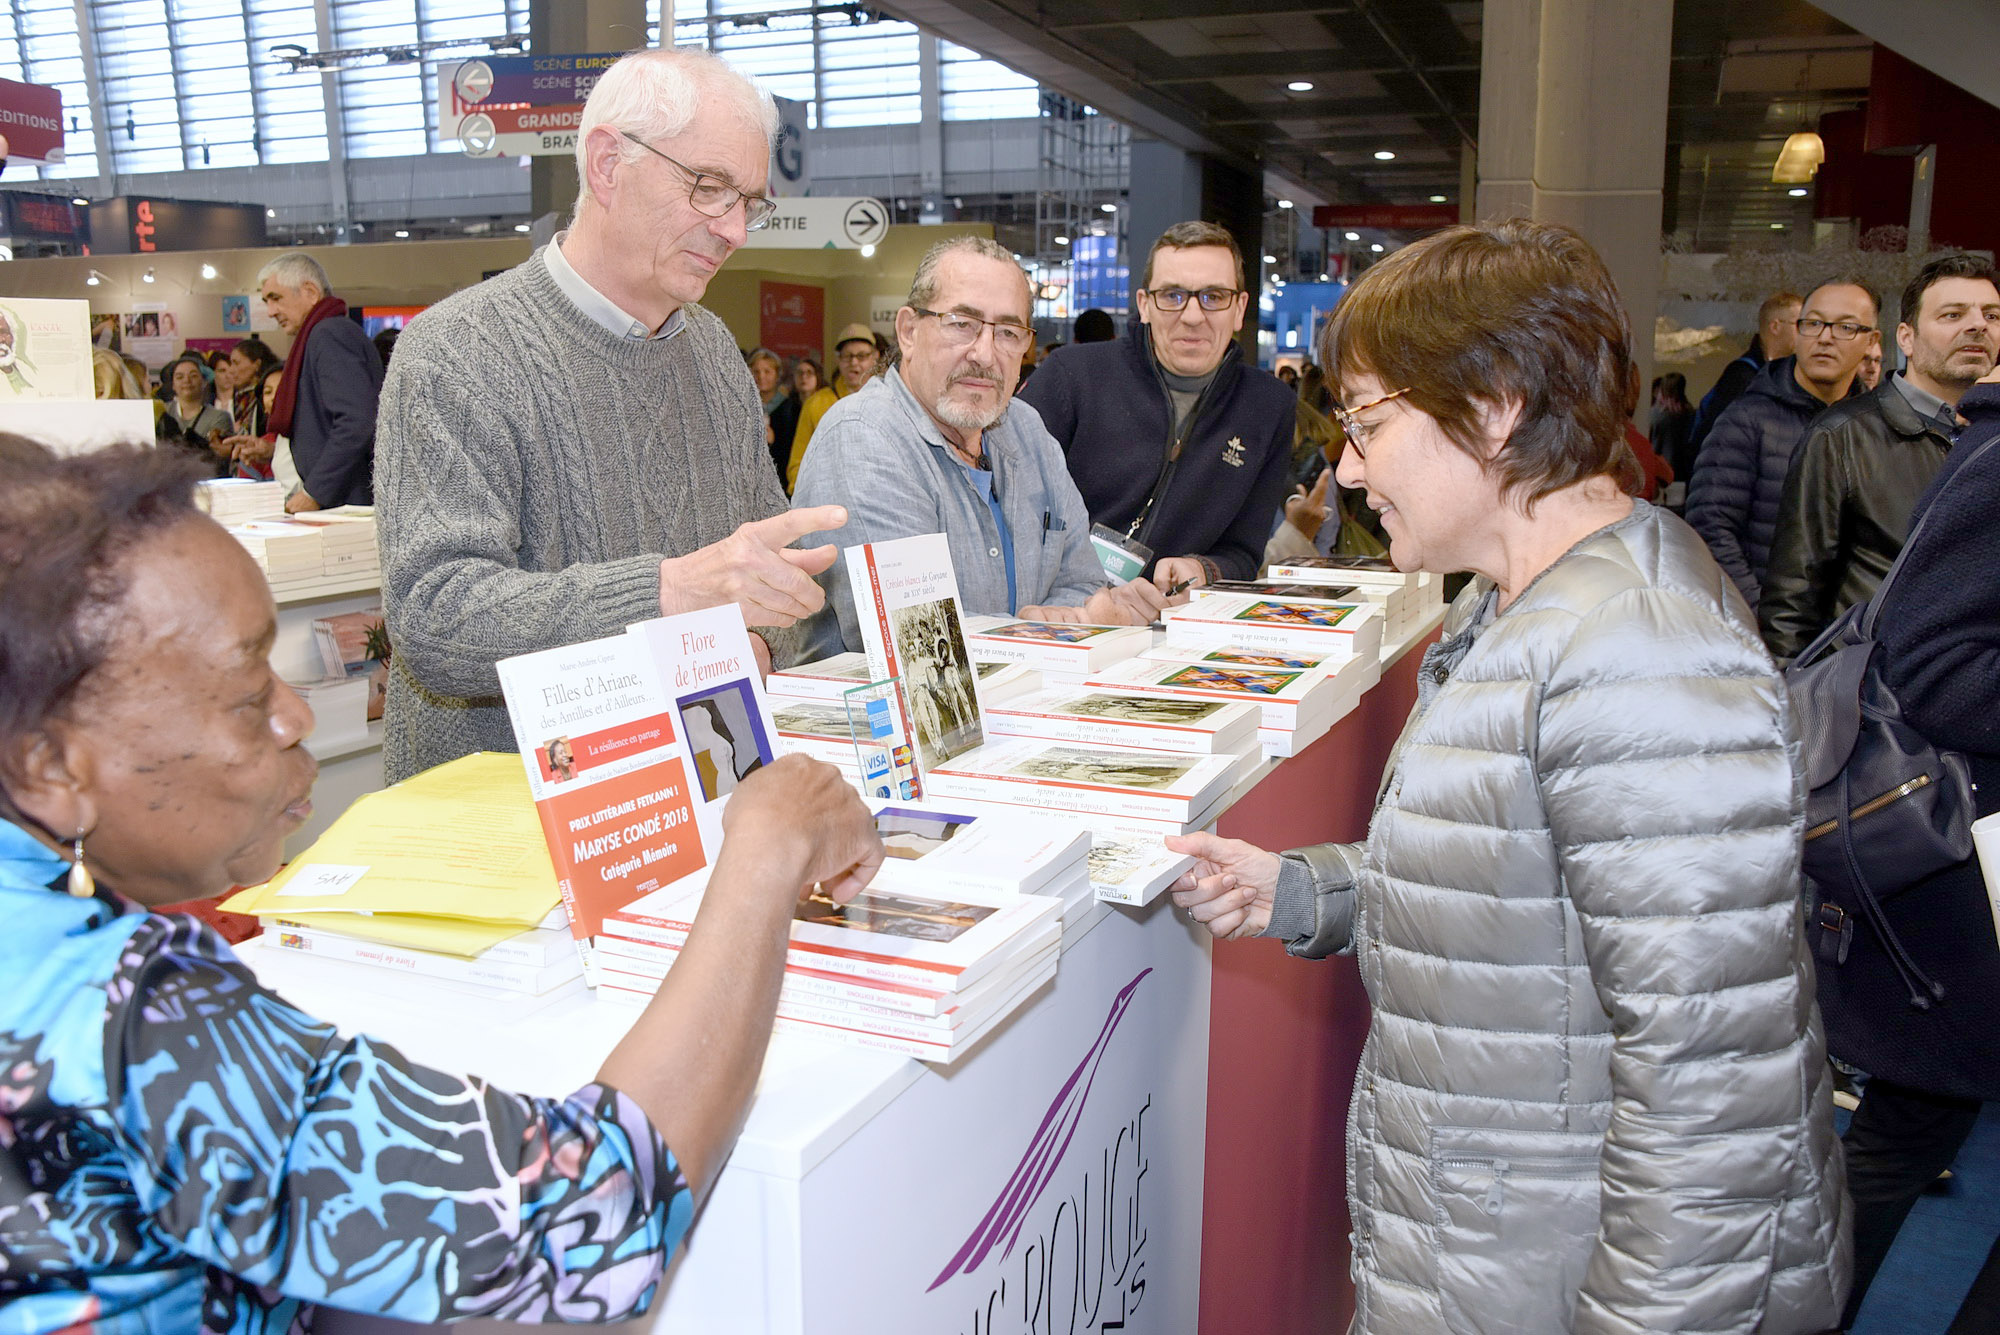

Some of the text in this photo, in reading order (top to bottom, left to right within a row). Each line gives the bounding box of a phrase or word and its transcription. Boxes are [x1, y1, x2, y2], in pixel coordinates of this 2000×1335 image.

[922, 572, 928, 582] de
[928, 571, 949, 584] Guyane
[682, 632, 716, 656] Flore
[1246, 634, 1253, 642] de
[1254, 635, 1270, 643] traces
[1279, 636, 1289, 644] Sur
[972, 648, 983, 656] Bon
[1015, 652, 1026, 660] Sur
[675, 656, 741, 689] de femmes
[542, 682, 581, 707] Filles
[540, 713, 557, 729] des
[559, 704, 594, 725] Antilles
[595, 703, 604, 716] et
[1076, 724, 1094, 732] siècle
[588, 728, 661, 756] La résilience en partage
[1055, 729, 1140, 746] Créoles blancs de Guyane
[867, 754, 888, 771] VISA
[1035, 788, 1056, 797] siècle
[568, 815, 592, 833] PRIX
[591, 800, 637, 825] LITTÉRAIRE
[636, 786, 674, 809] FETKANN
[1012, 794, 1108, 813] Créoles blancs de Guyane
[573, 805, 690, 864] MARYSE CONDÉ 2018
[600, 841, 678, 881] Catégorie Mémoire
[1099, 890, 1132, 901] FORTUNA
[355, 950, 416, 968] Flore de femmes
[866, 968, 895, 979] EDITIONS
[847, 991, 875, 1001] EDITIONS
[862, 1022, 891, 1032] EDITIONS
[858, 1039, 886, 1049] EDITIONS
